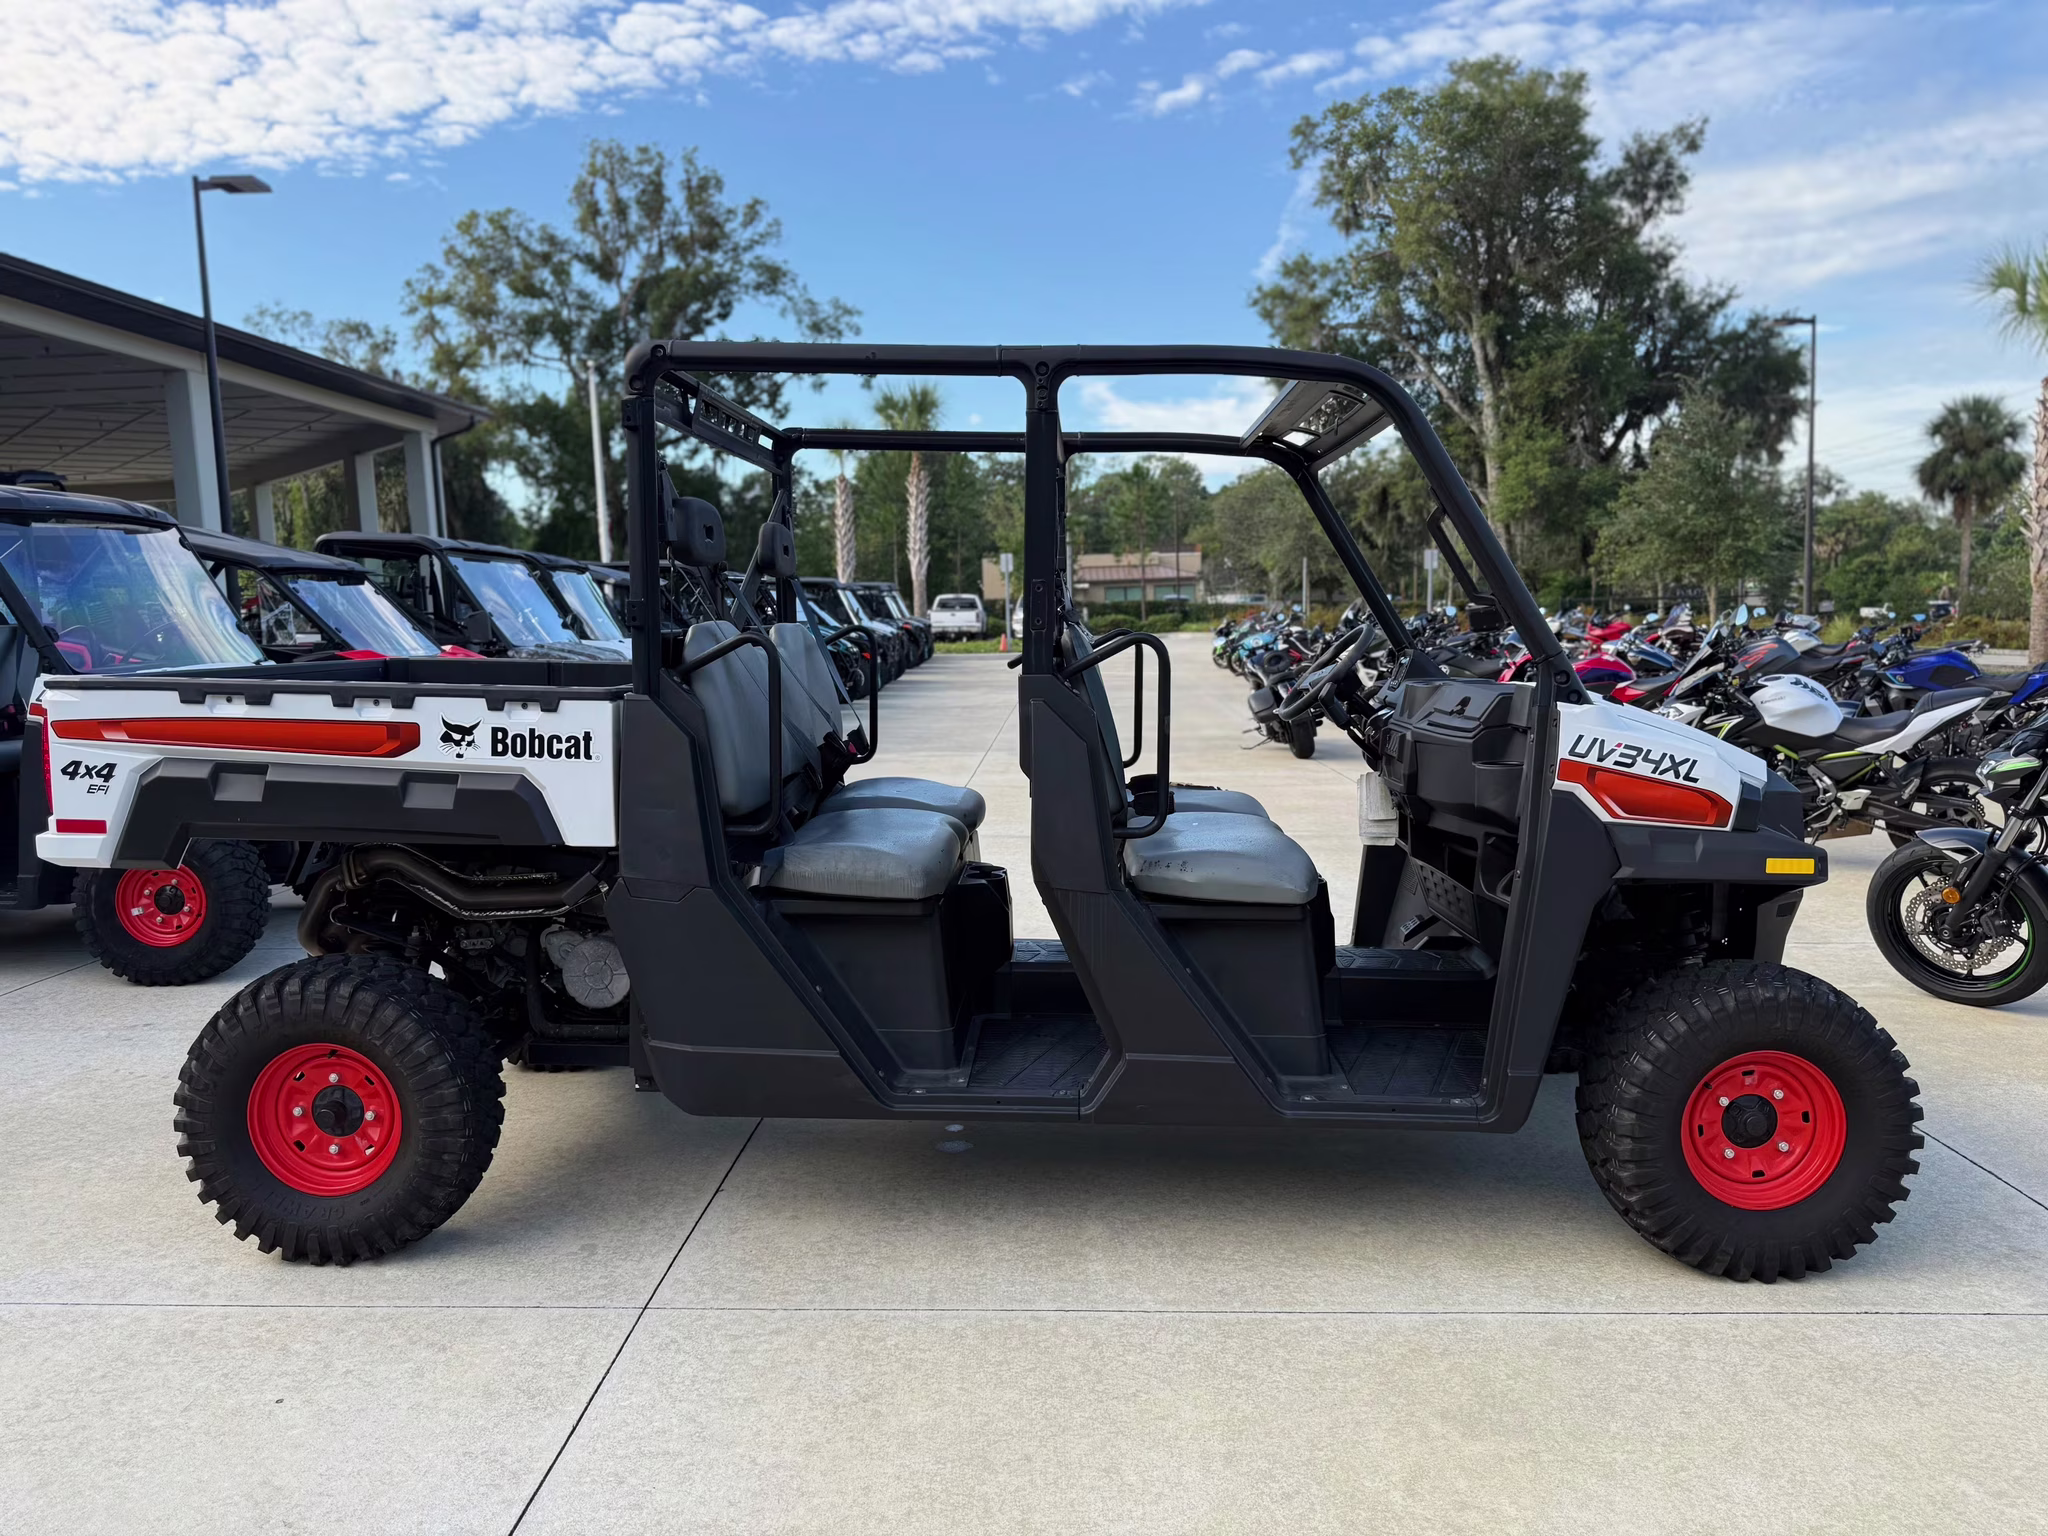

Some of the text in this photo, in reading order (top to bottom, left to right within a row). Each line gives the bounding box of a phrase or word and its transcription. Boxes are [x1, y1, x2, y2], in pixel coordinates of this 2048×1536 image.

[490, 726, 593, 761] Bobcat
[60, 760, 118, 783] 4x4
[1567, 734, 1700, 784] UV34XL
[86, 784, 110, 795] EFI
